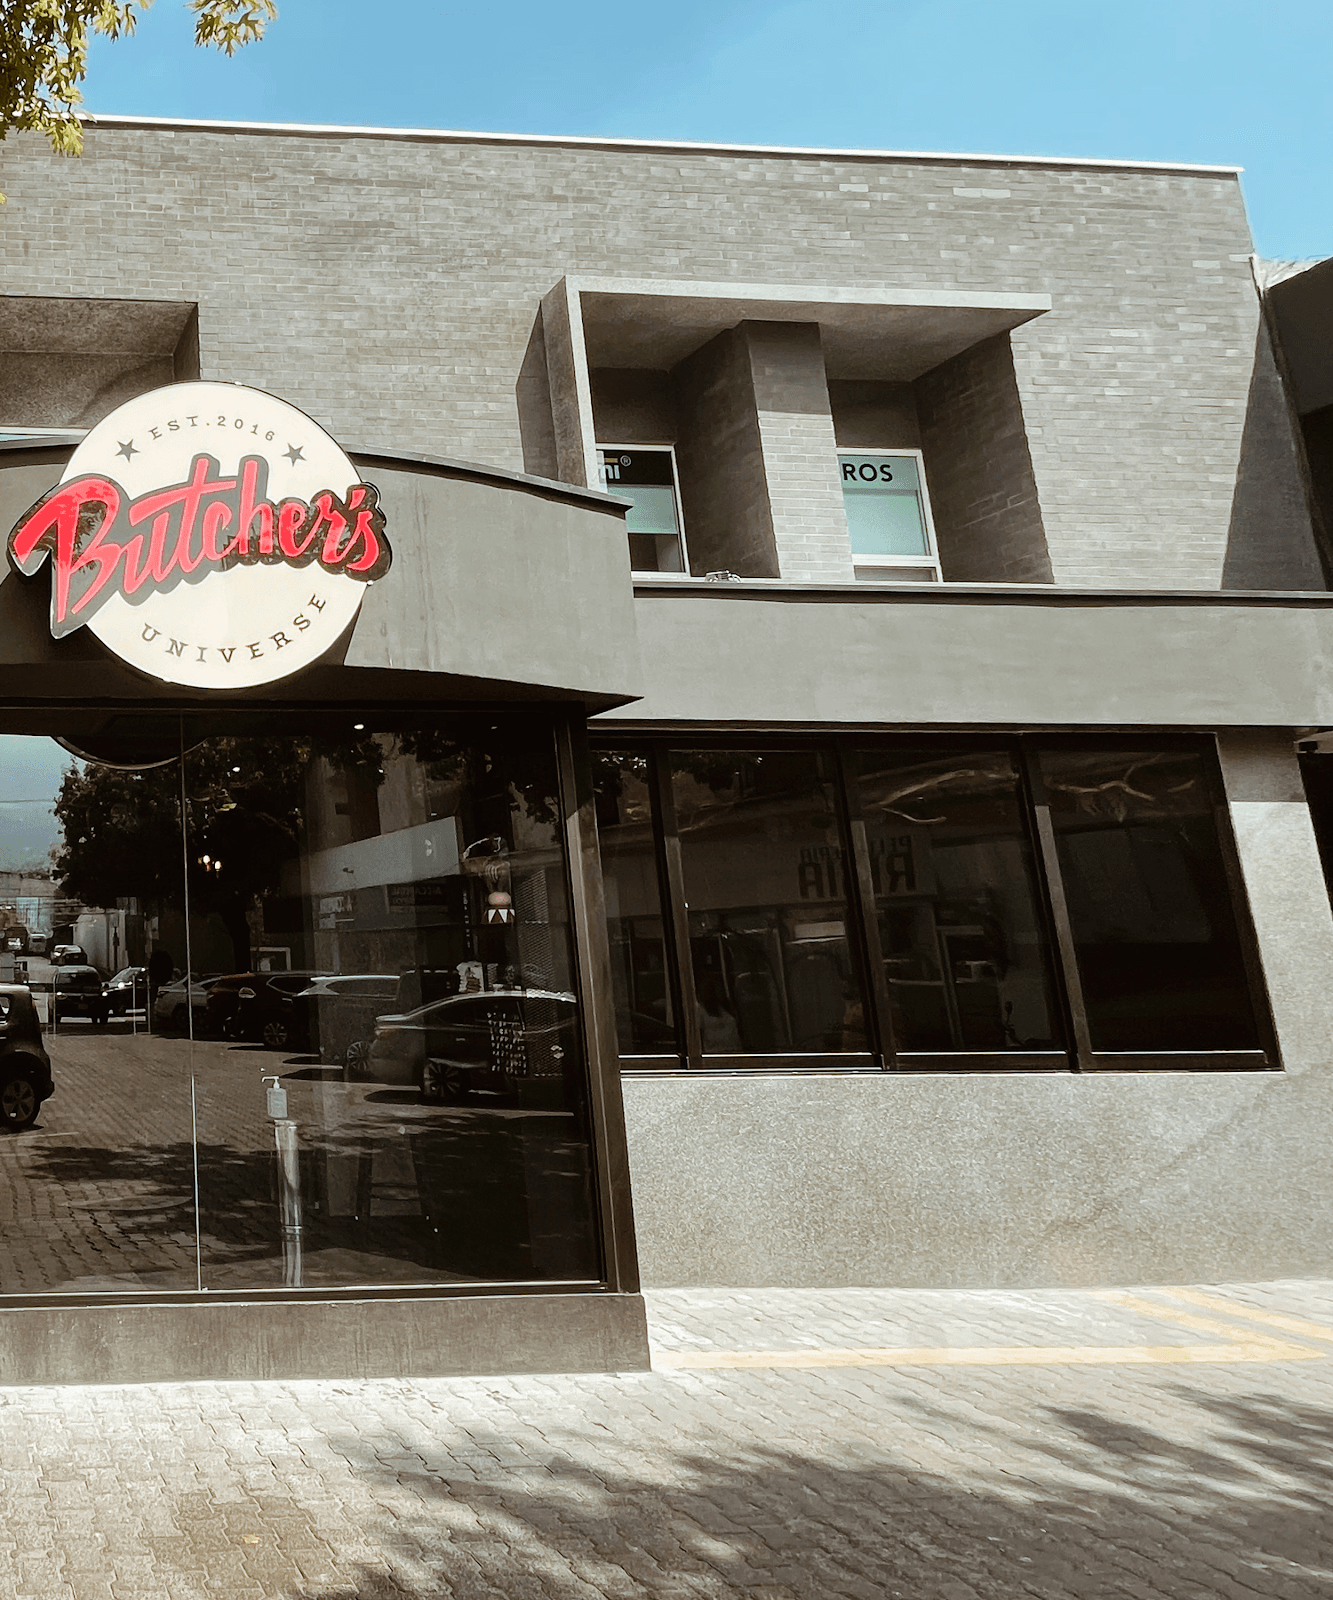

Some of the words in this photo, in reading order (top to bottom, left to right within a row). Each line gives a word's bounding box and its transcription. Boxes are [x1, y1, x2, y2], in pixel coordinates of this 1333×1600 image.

[842, 463, 893, 483] ROS
[11, 455, 381, 625] Butcher's
[139, 593, 328, 664] UNIVERSE
